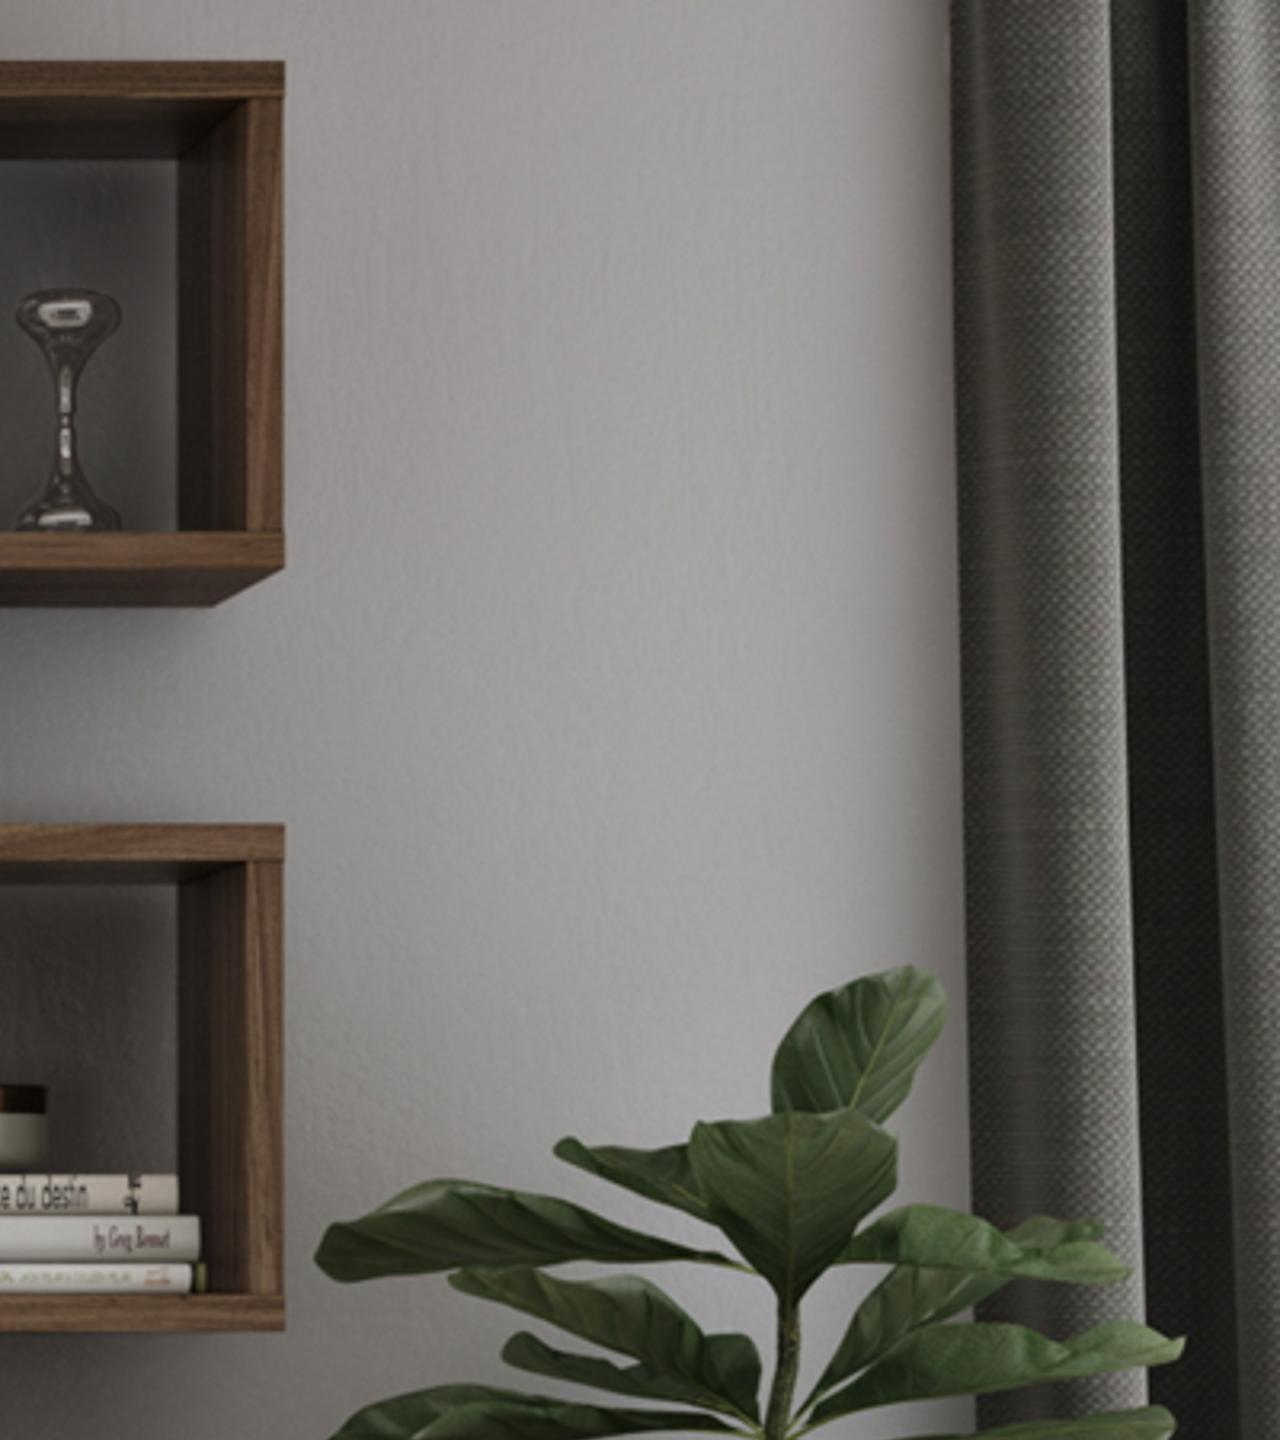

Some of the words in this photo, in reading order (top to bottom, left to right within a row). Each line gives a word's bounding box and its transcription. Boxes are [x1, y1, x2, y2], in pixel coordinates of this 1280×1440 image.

[14, 1175, 37, 1209] du
[41, 1174, 88, 1209] destin
[93, 1224, 106, 1254] by
